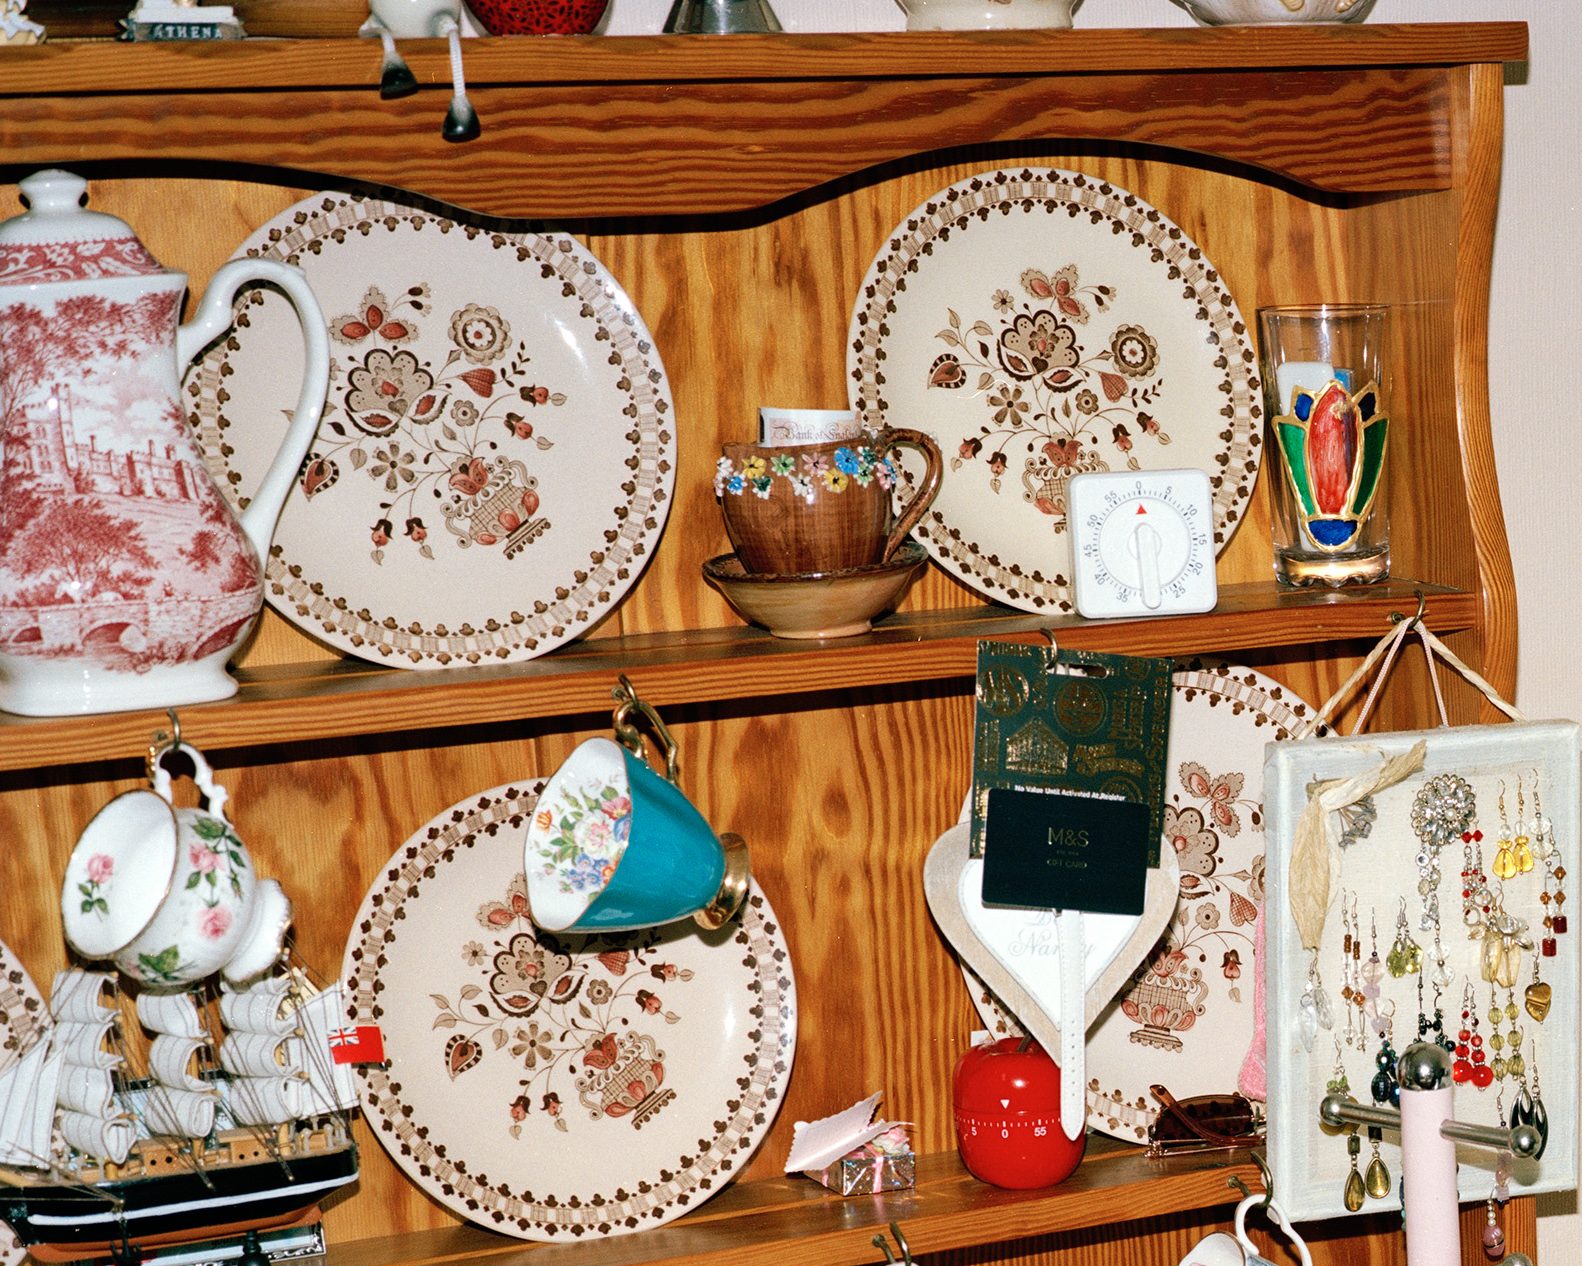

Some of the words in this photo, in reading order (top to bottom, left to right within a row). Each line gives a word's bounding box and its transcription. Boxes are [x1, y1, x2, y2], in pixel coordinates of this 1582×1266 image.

[153, 24, 222, 39] ATHENA
[1135, 480, 1142, 490] 0
[1165, 486, 1173, 495] 5
[1104, 490, 1118, 503] 55
[1187, 504, 1198, 516] 10
[1087, 514, 1098, 528] 50
[1198, 533, 1207, 545] 15
[1083, 544, 1092, 557] 45
[1192, 562, 1204, 576] 20
[1094, 573, 1106, 586] 40
[1116, 591, 1128, 603] 35
[1173, 586, 1186, 598] 25
[1014, 784, 1025, 793] No
[1025, 785, 1044, 794] Value
[1044, 787, 1060, 796] Until
[1061, 789, 1091, 799] Activated
[1048, 827, 1089, 848] M&S
[971, 1126, 977, 1136] 5
[1001, 1129, 1009, 1139] 0
[1034, 1126, 1047, 1137] 55
